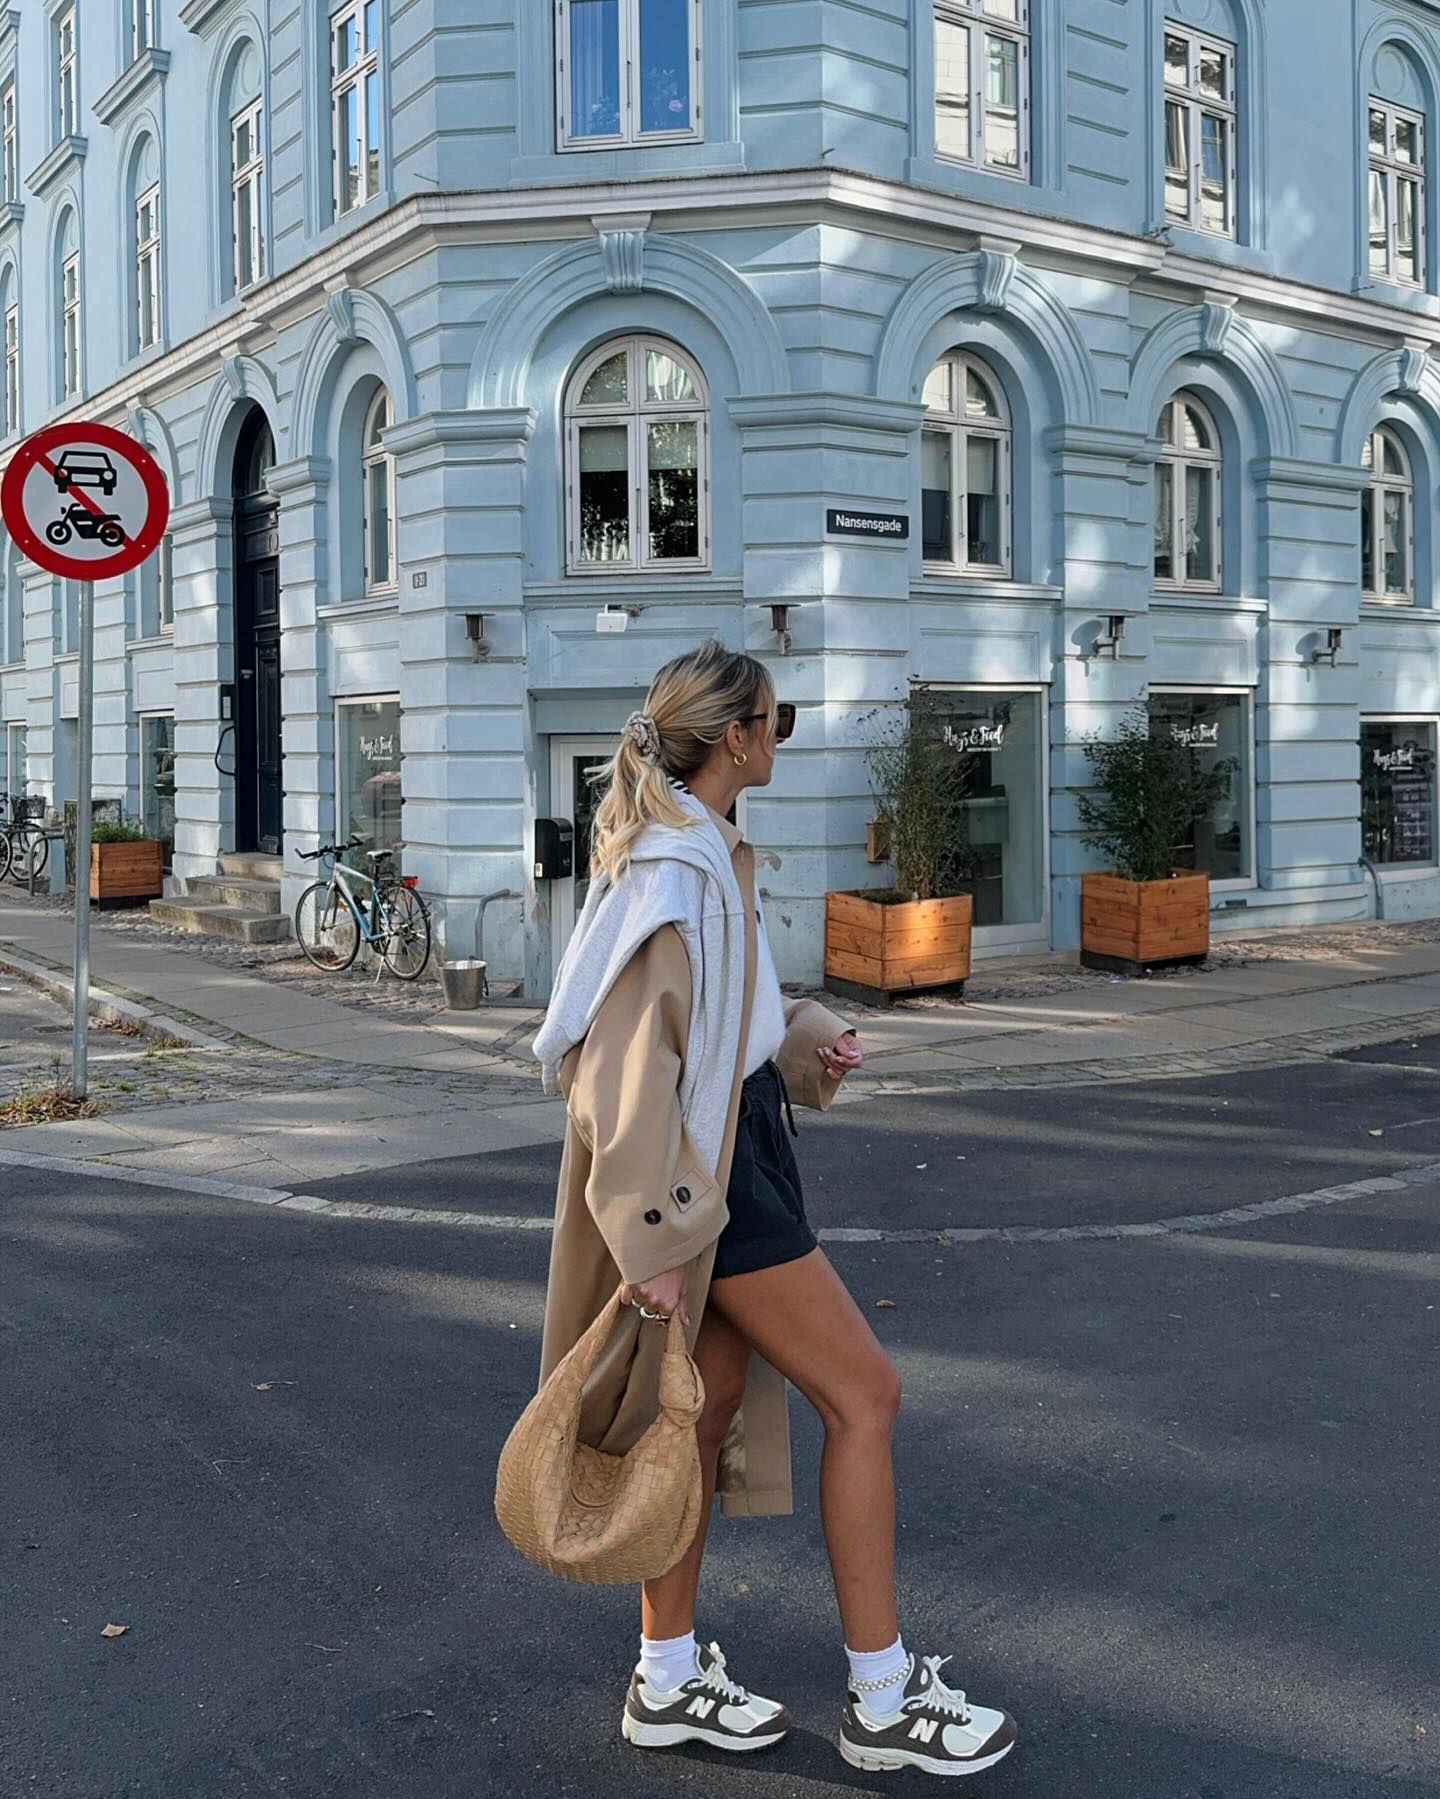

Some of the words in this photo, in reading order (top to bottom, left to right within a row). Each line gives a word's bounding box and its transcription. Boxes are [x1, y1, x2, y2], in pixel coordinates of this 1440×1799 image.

[835, 514, 902, 533] Nansensgade
[943, 725, 968, 752] Hugs
[969, 728, 979, 745] &
[685, 1695, 717, 1719] N
[908, 1717, 939, 1744] N
